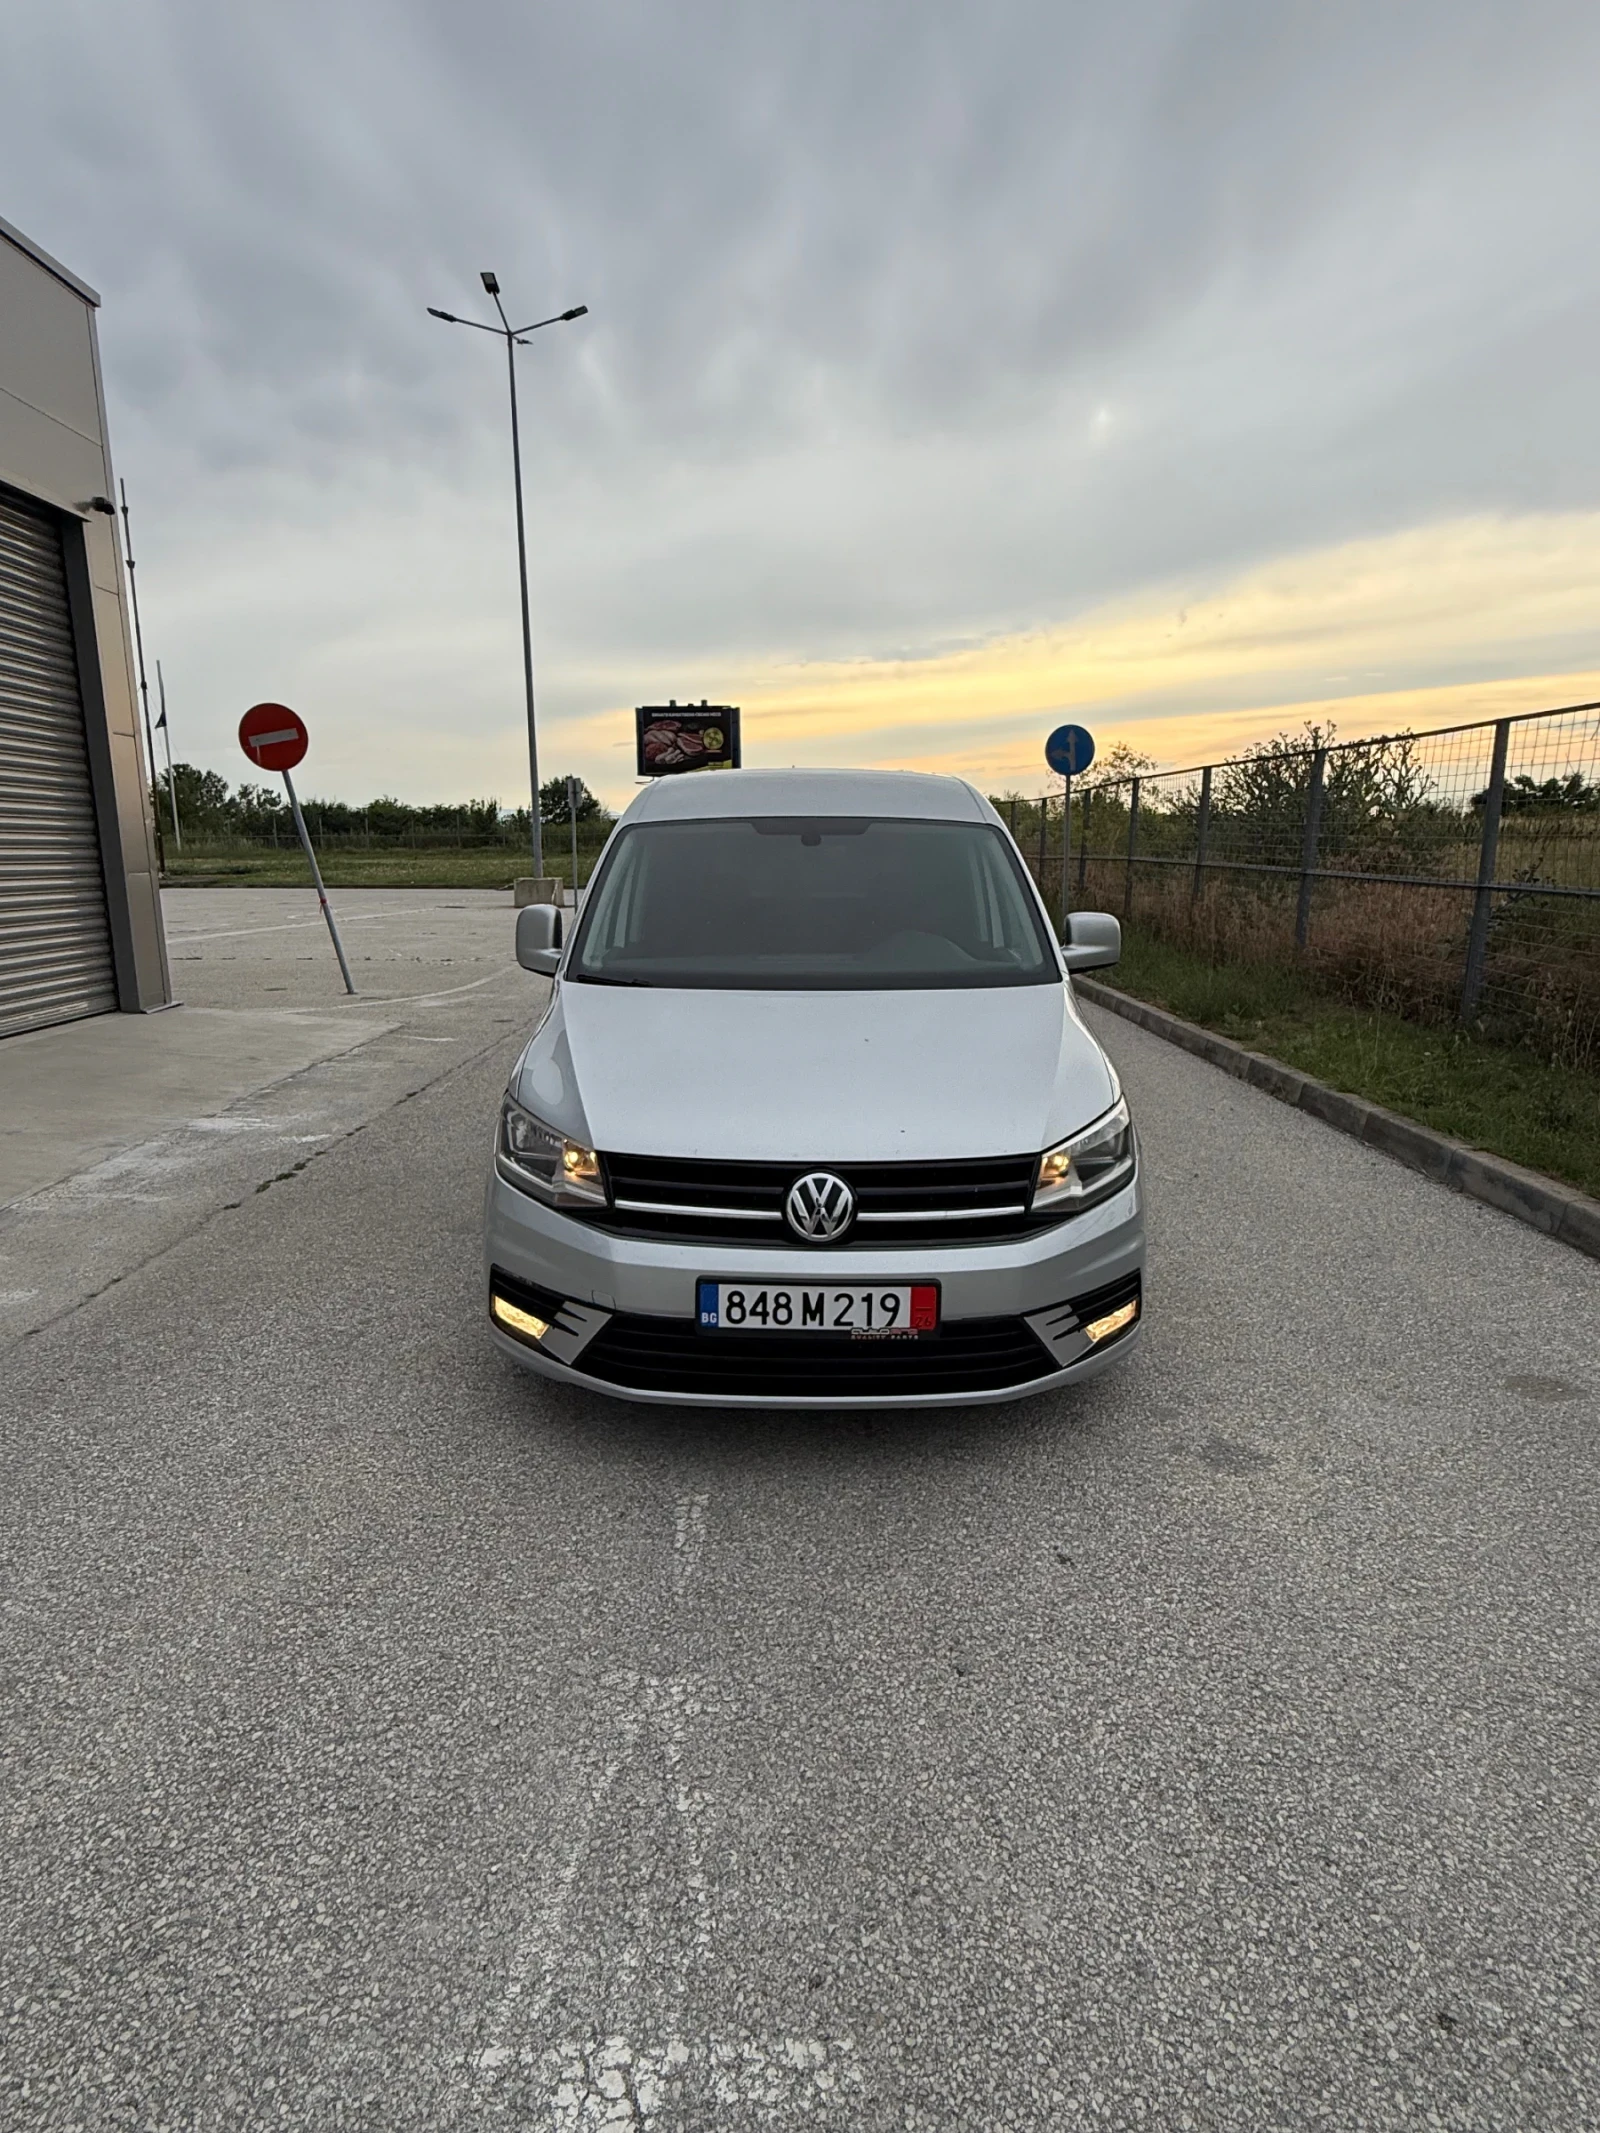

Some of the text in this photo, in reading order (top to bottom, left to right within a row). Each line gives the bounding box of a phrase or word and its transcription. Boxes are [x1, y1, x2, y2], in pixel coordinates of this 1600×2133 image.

[701, 1312, 718, 1324] BG
[725, 1290, 901, 1327] 848 M 219
